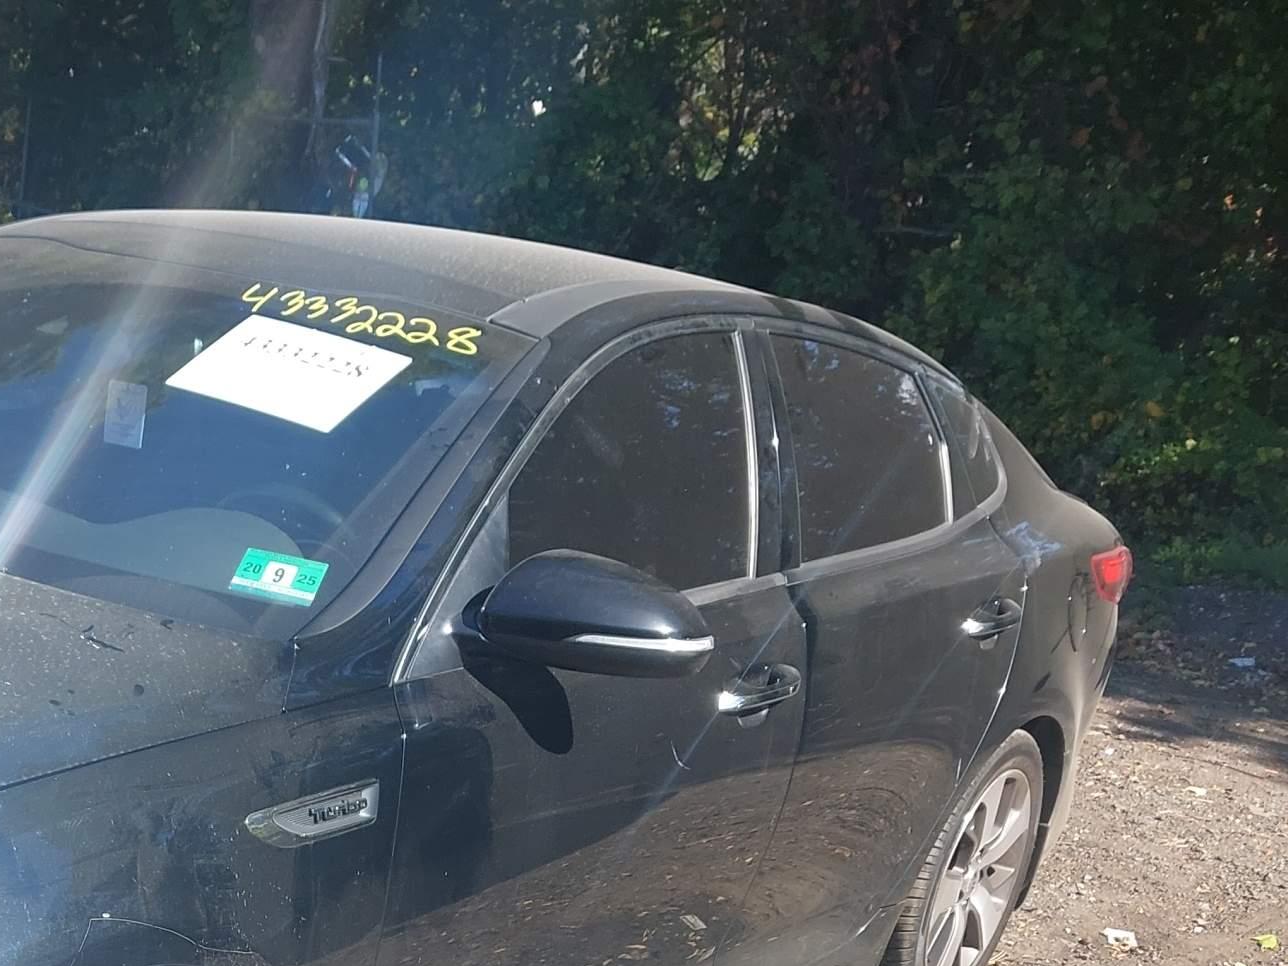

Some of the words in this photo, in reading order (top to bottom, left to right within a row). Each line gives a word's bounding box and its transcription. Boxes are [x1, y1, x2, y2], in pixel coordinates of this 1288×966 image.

[241, 283, 482, 355] 43332228
[243, 561, 262, 574] 20
[272, 567, 286, 583] 9
[296, 574, 318, 586] 25
